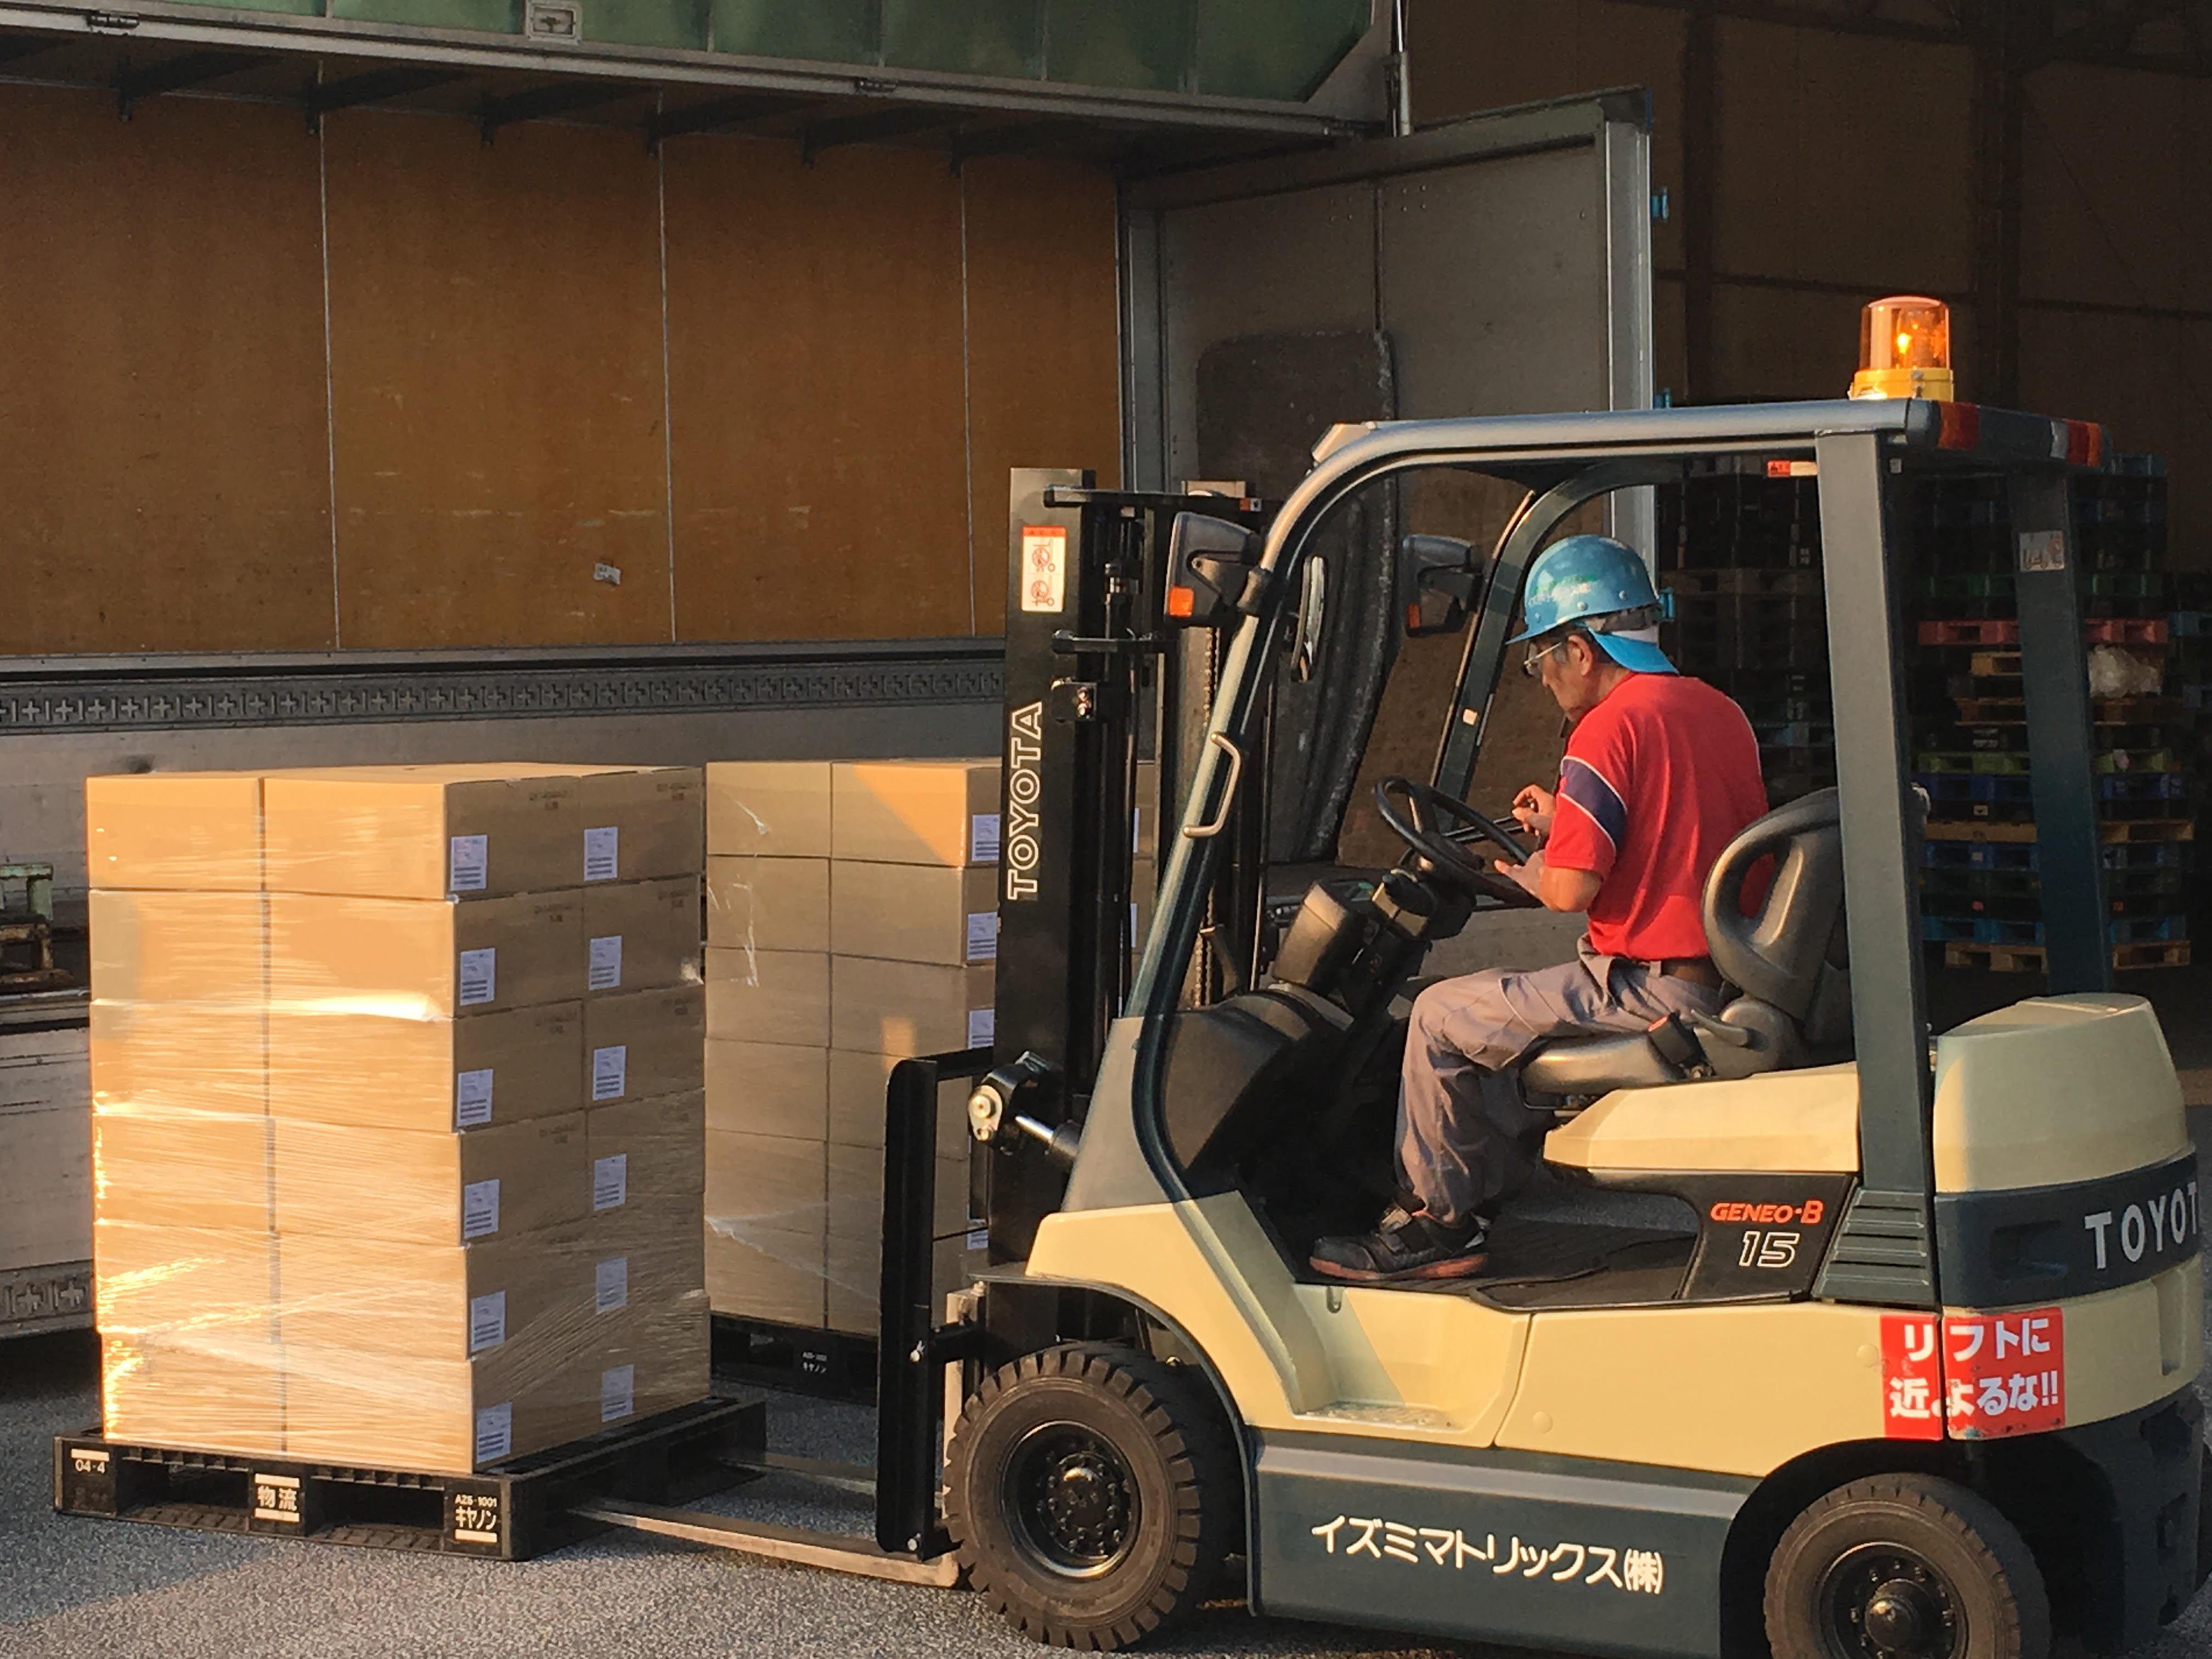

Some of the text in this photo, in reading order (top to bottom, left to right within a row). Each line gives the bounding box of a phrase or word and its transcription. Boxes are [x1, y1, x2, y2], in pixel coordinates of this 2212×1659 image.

[1007, 701, 1043, 901] TOYOTA
[1738, 1231, 1801, 1268] 15
[1904, 1318, 2051, 1362] リフトに
[257, 1485, 297, 1511] 物流
